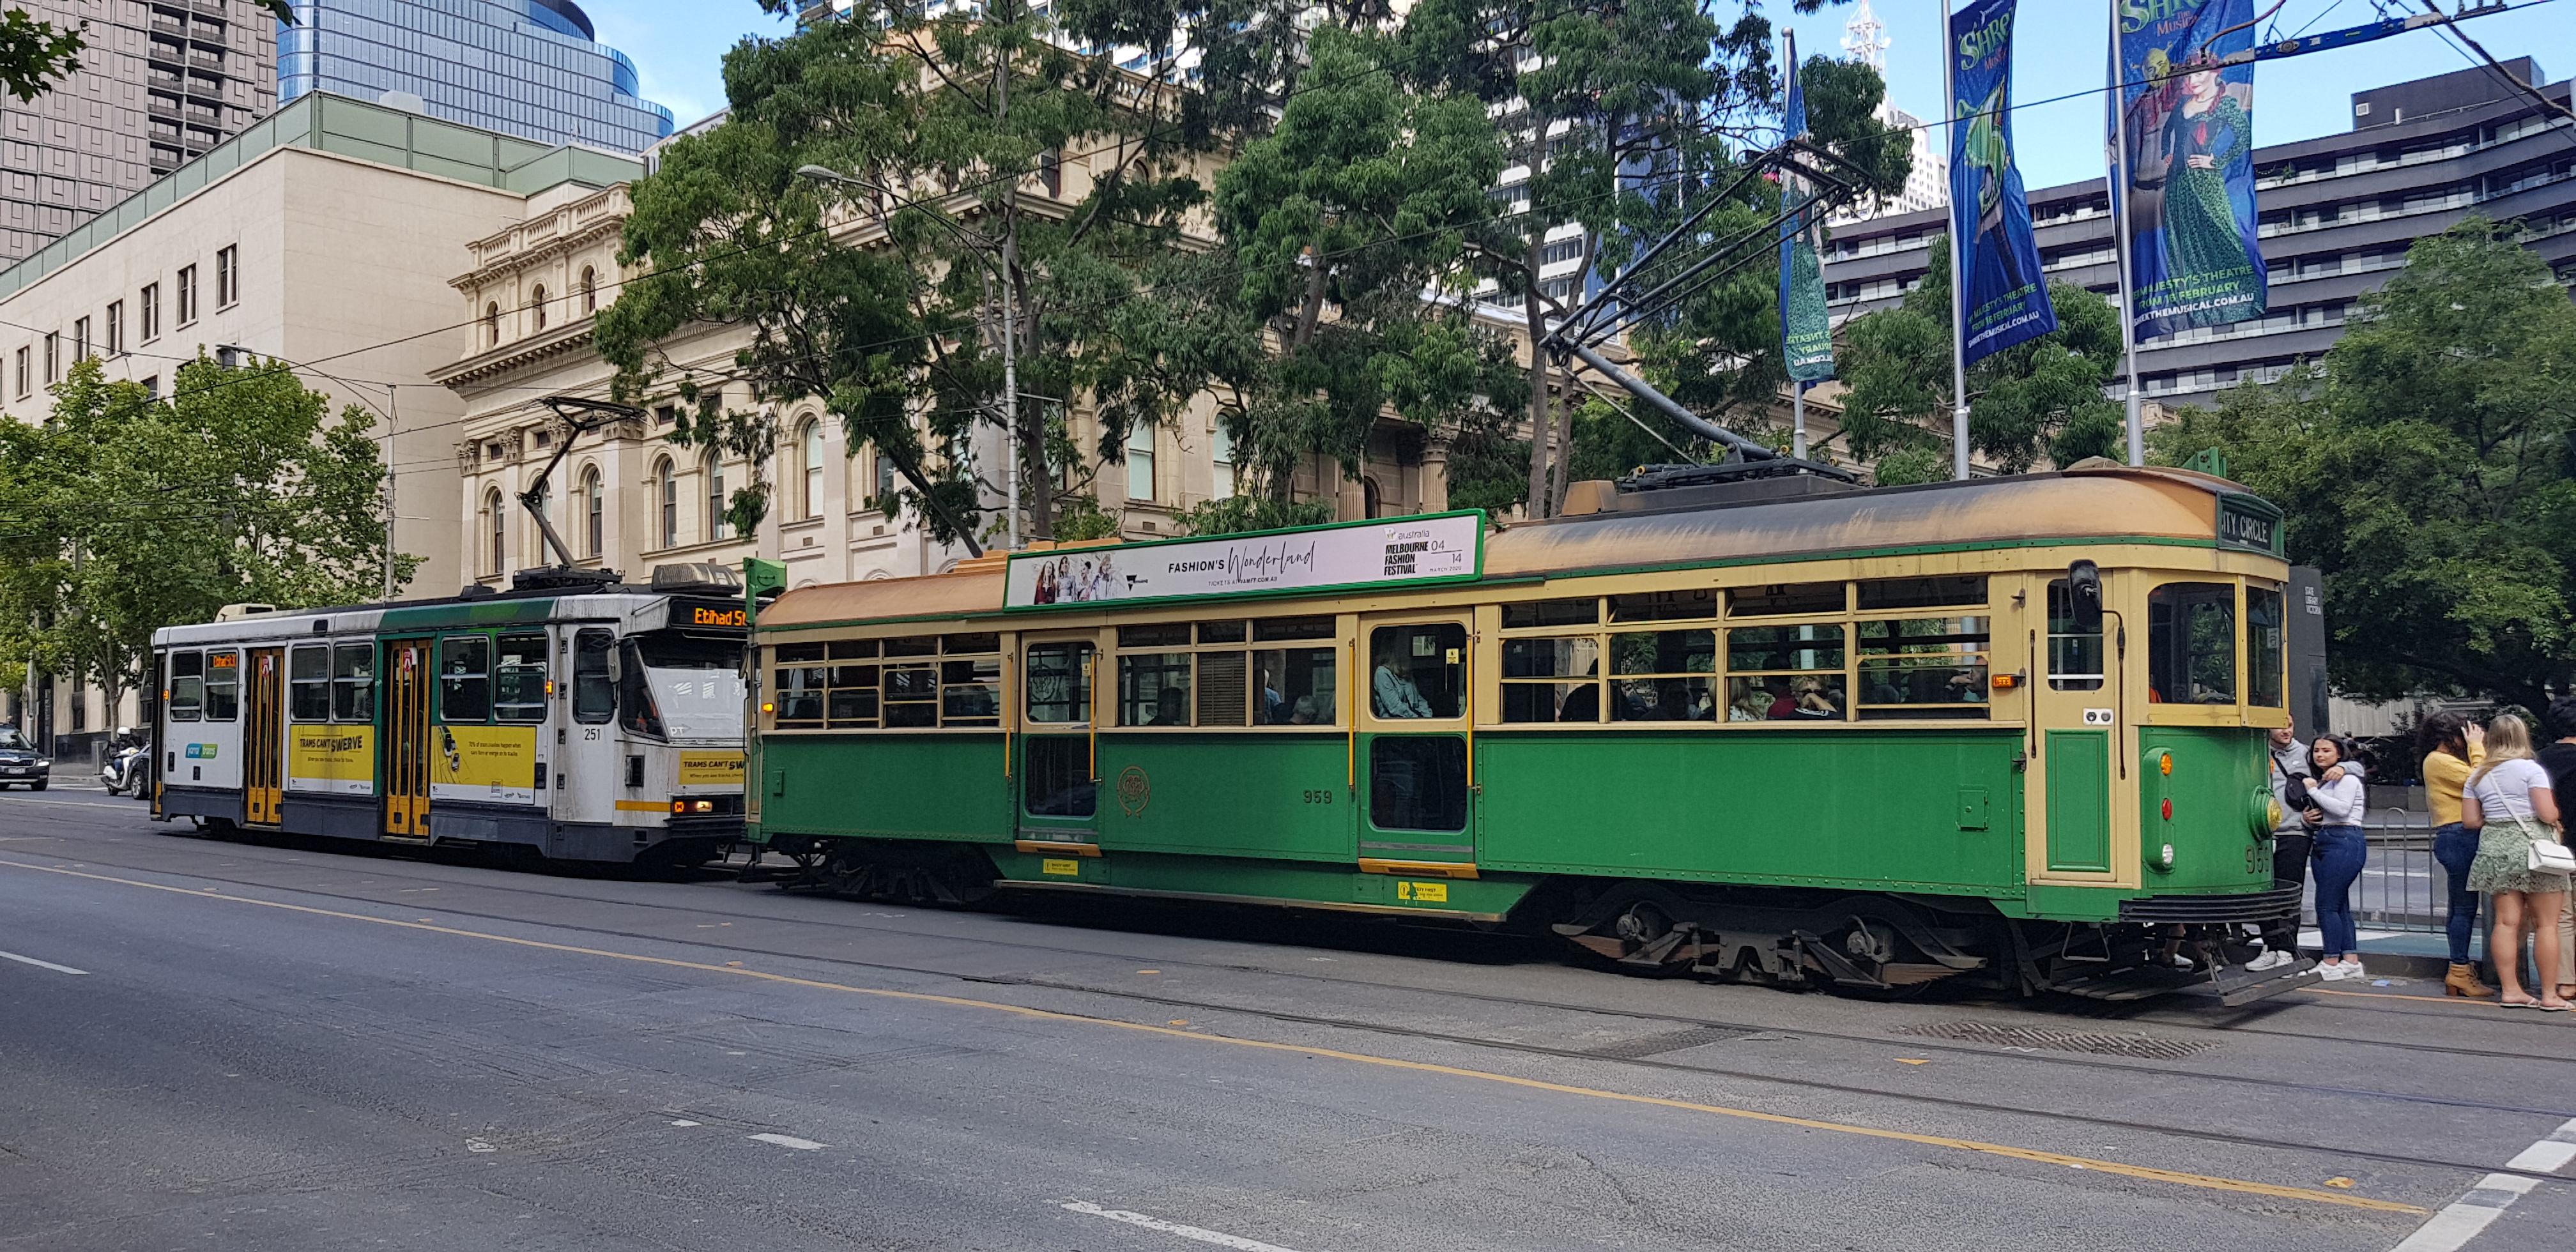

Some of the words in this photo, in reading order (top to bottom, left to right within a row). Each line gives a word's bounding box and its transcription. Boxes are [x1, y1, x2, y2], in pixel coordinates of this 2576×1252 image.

[2141, 274, 2200, 298] MAJESTY'S
[2204, 264, 2254, 283] THEATRE
[2002, 282, 2037, 302] THEATRE
[2179, 280, 2240, 302] FEBRUARY
[1398, 529, 1430, 540] australia
[2240, 515, 2267, 542] CIRCLE
[1385, 541, 1429, 555] MELBOURNE
[1430, 540, 1445, 551] 04
[1168, 560, 1225, 574] FASHION'S
[1228, 540, 1315, 583] Wonderland
[1384, 553, 1416, 566] FASHION
[1452, 553, 1462, 564] 14
[1384, 564, 1416, 576] FESTIVAL
[694, 607, 733, 626] Etihad
[584, 728, 601, 741] 251
[300, 738, 316, 747] TRAMS
[316, 738, 330, 748] CAN'T
[331, 735, 363, 752] SWERVE
[1303, 790, 1332, 804] 959
